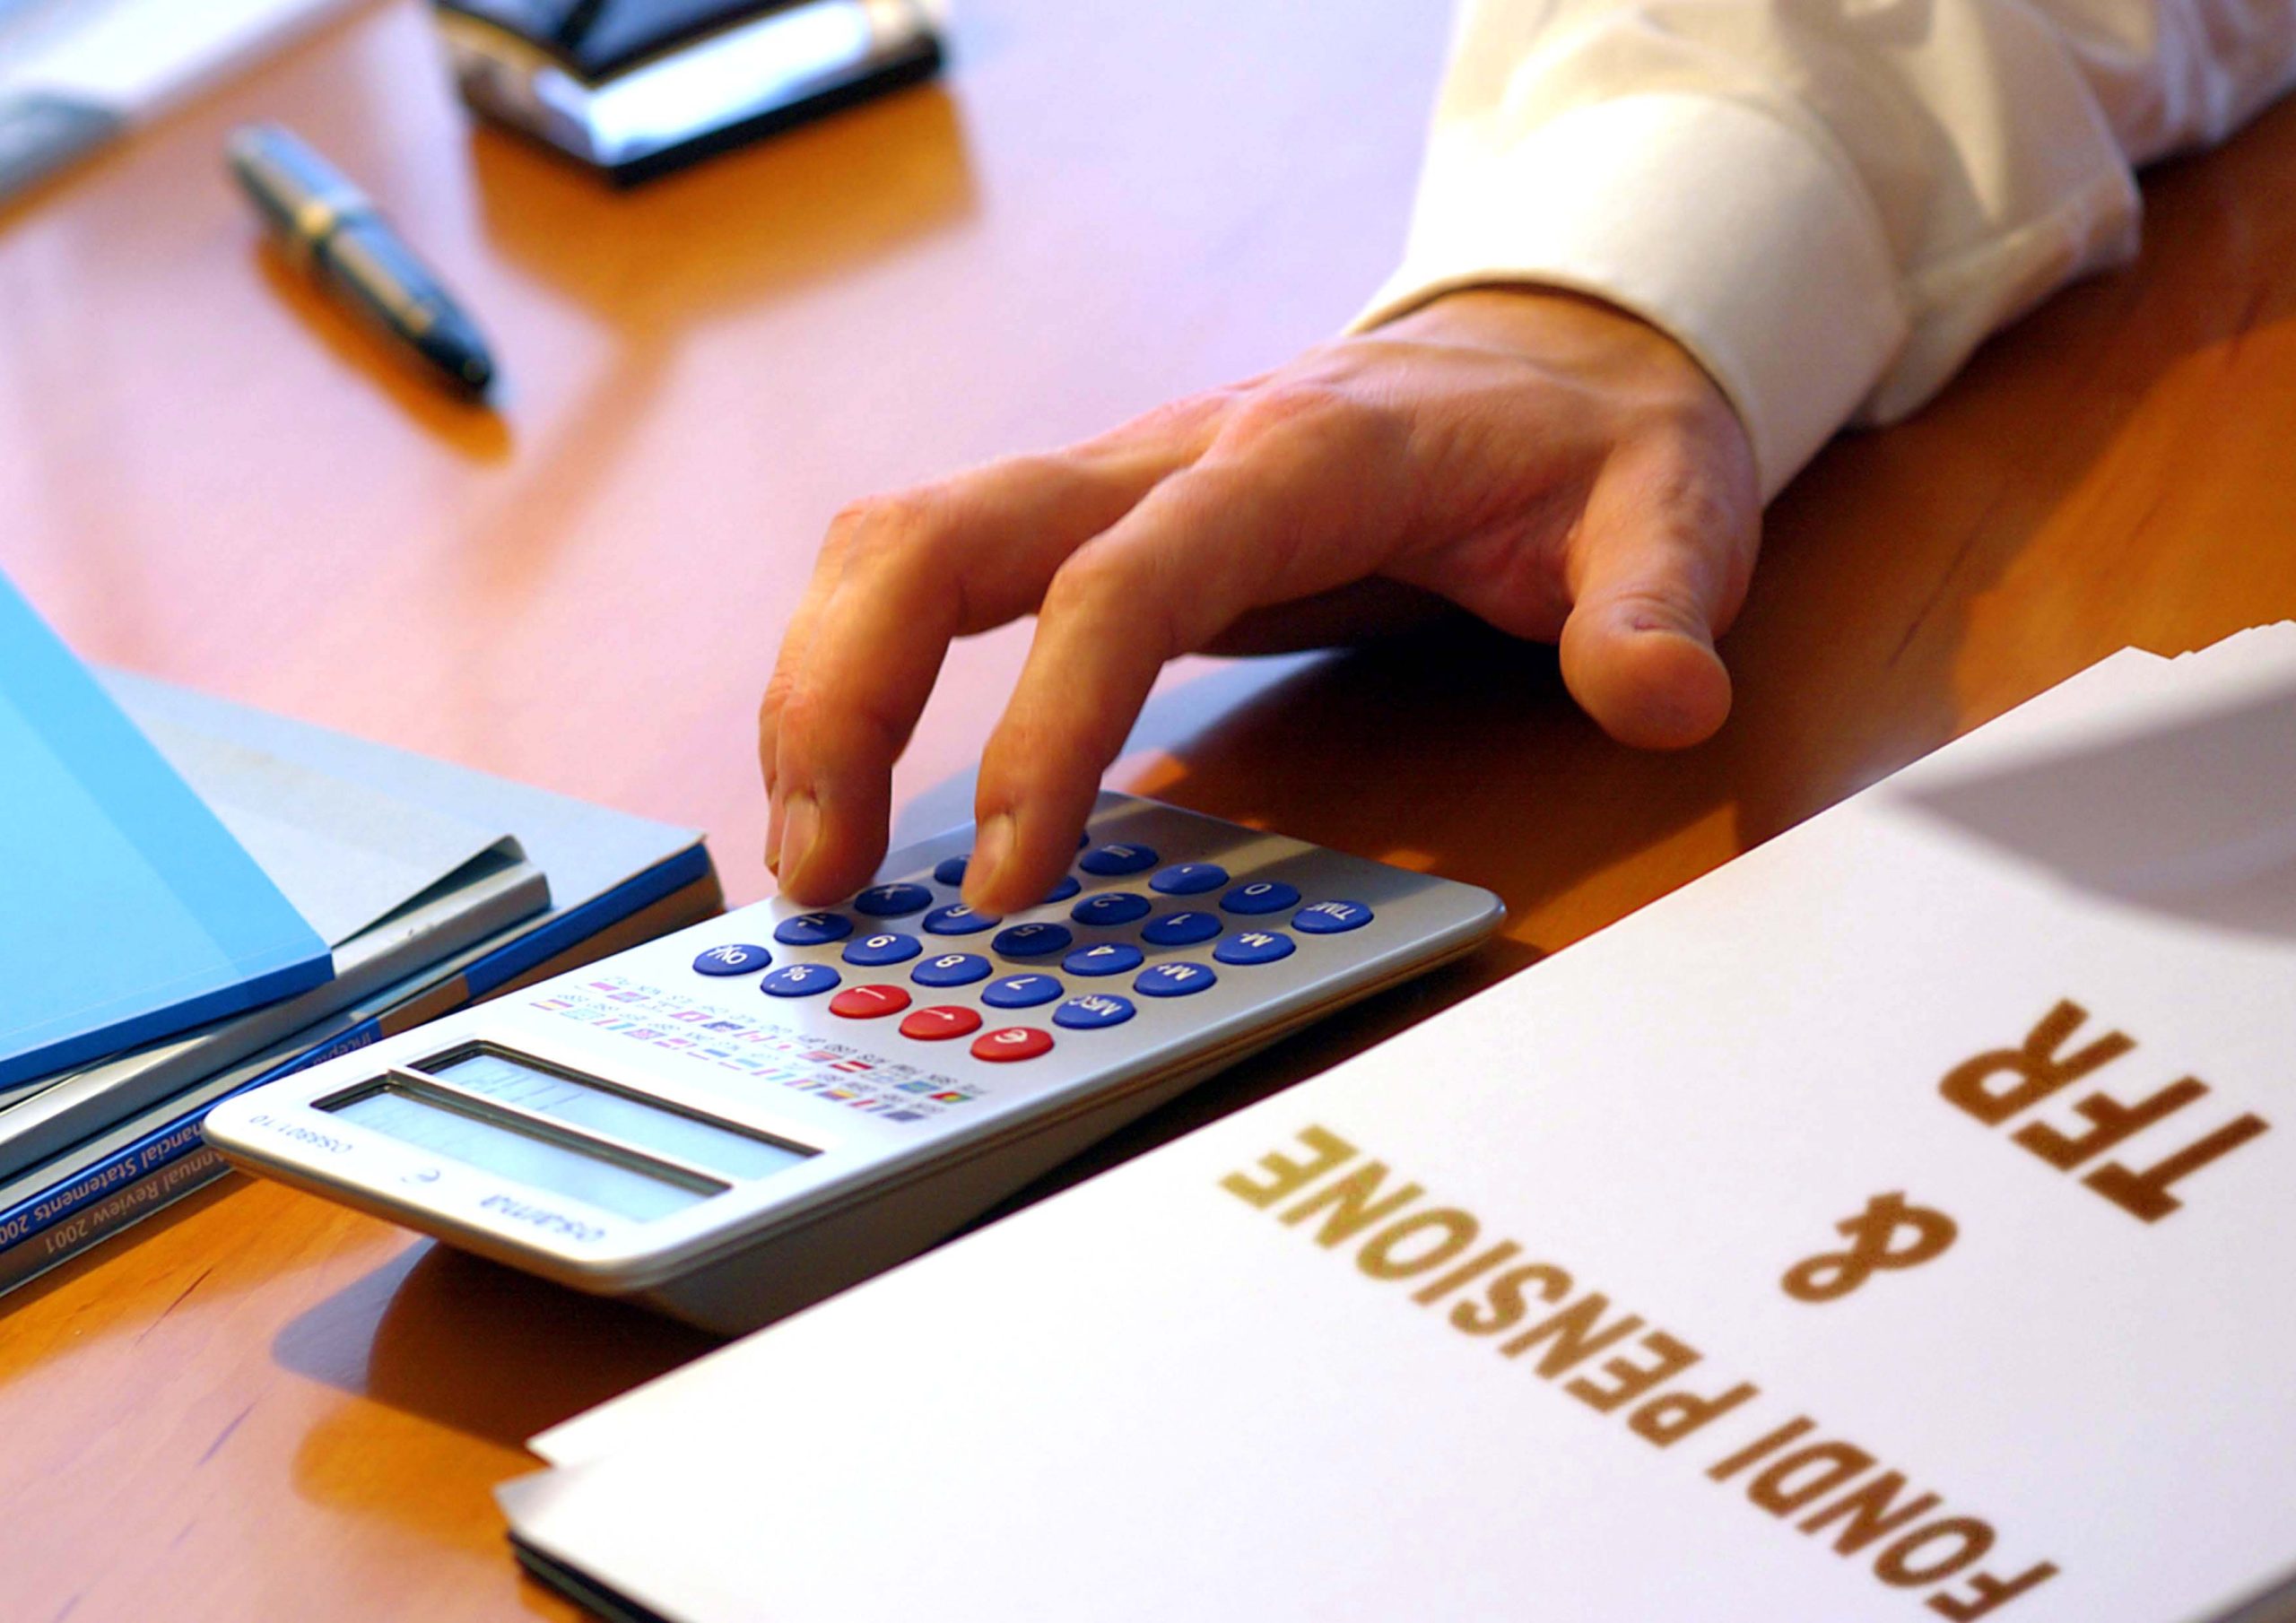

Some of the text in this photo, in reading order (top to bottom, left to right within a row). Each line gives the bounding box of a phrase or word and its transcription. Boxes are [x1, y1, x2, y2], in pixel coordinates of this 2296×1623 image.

[1092, 894, 1125, 908] 2
[1013, 924, 1045, 938] 5
[1167, 913, 1192, 926] 1
[935, 954, 966, 968] 8
[1086, 944, 1116, 958] 4
[1003, 976, 1039, 991] 7
[1937, 998, 2273, 1225] TFR
[0, 1121, 205, 1246] nancial Statements 200
[93, 1179, 161, 1227] Review
[46, 1217, 89, 1254] 2001
[1779, 1191, 1959, 1303] &
[1216, 1124, 2061, 1623] FONDI PENSIONE
